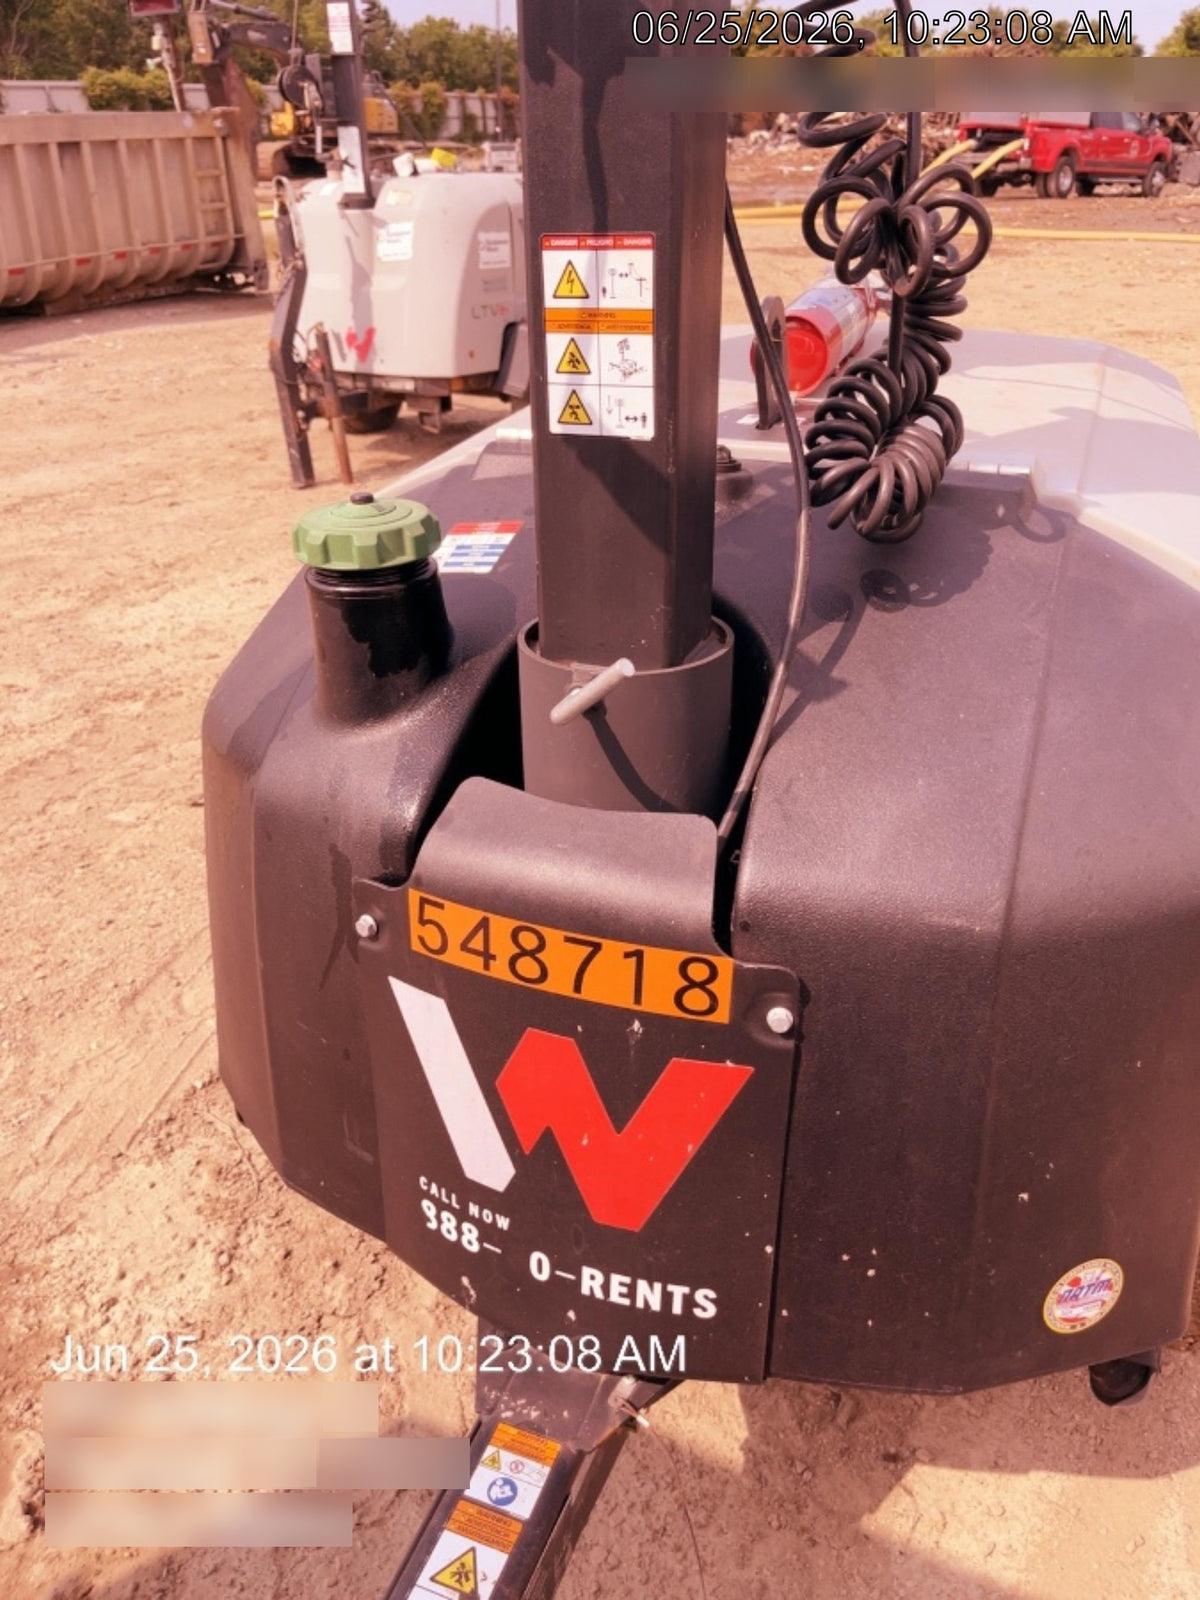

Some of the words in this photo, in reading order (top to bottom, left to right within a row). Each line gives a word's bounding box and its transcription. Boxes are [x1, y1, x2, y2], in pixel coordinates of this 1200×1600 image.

[417, 895, 720, 1017] 548718
[419, 1175, 460, 1210] CALL
[469, 1201, 510, 1231] NOW
